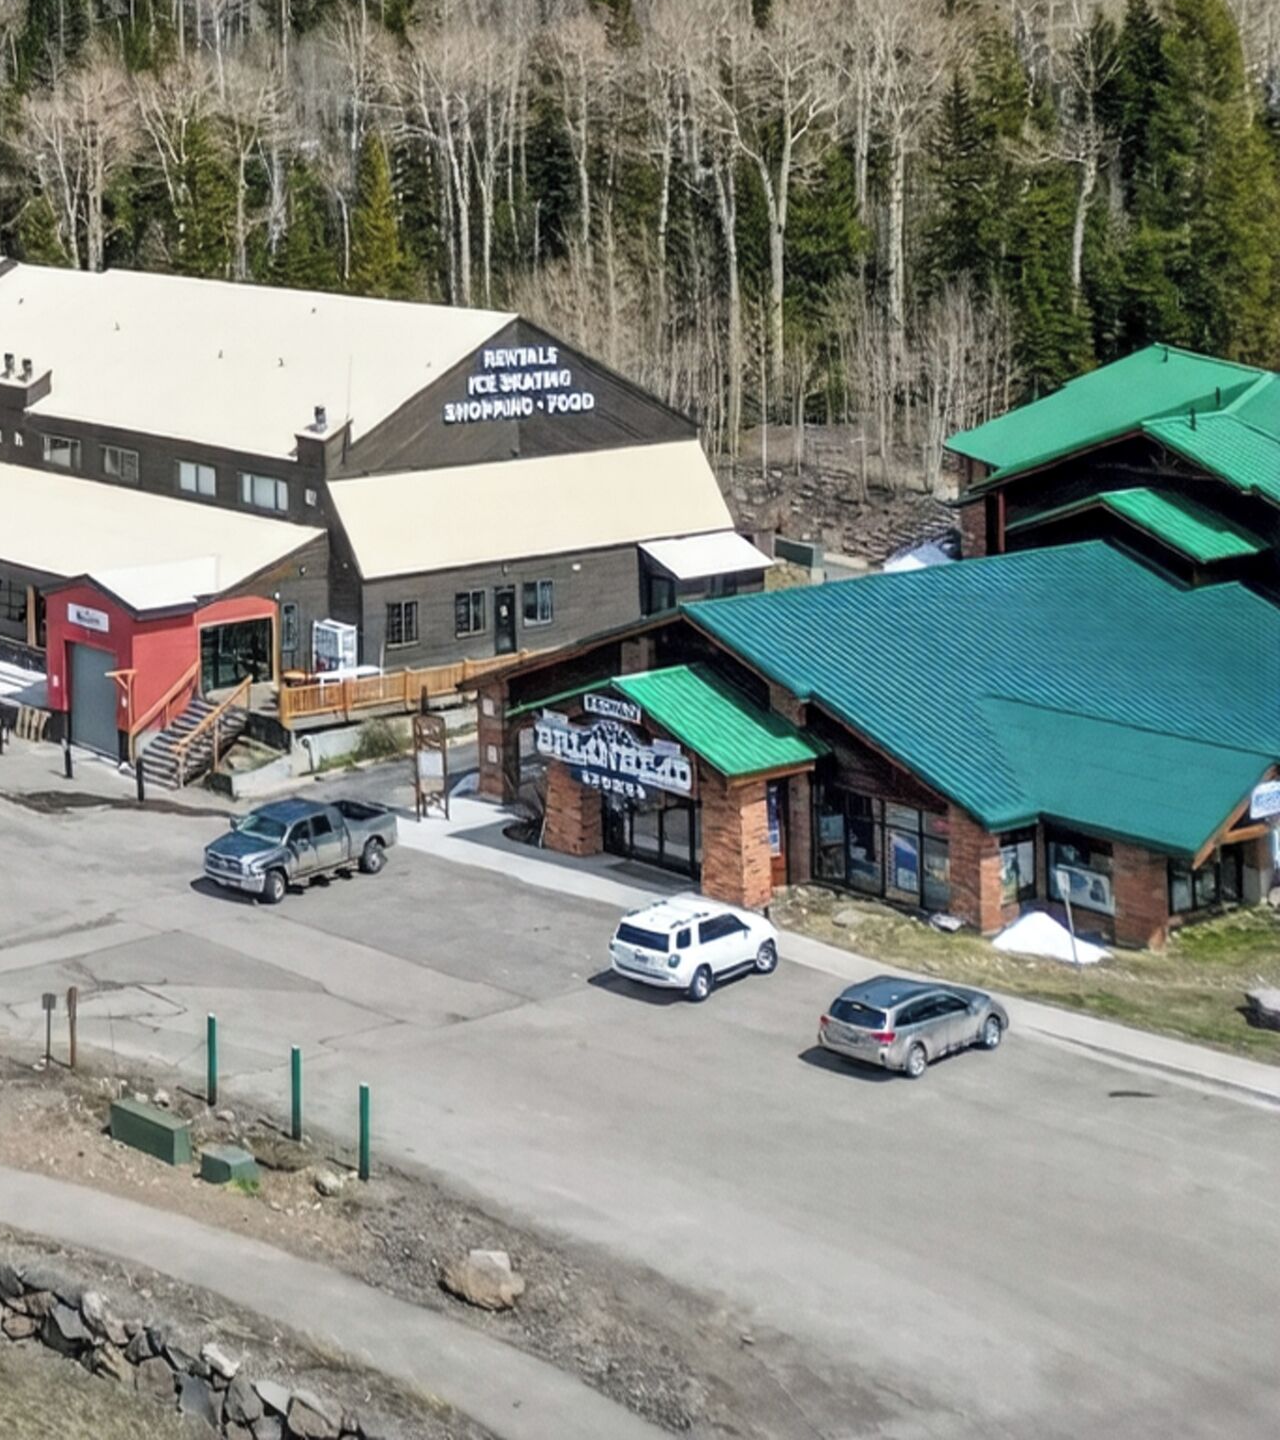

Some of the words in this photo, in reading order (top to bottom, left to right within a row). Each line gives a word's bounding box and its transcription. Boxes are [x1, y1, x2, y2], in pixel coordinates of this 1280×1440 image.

[484, 346, 559, 368] RENTALS
[468, 375, 498, 395] ICE
[499, 370, 571, 392] SKATING
[444, 397, 533, 422] SHOPPING
[547, 393, 594, 414] FOOD
